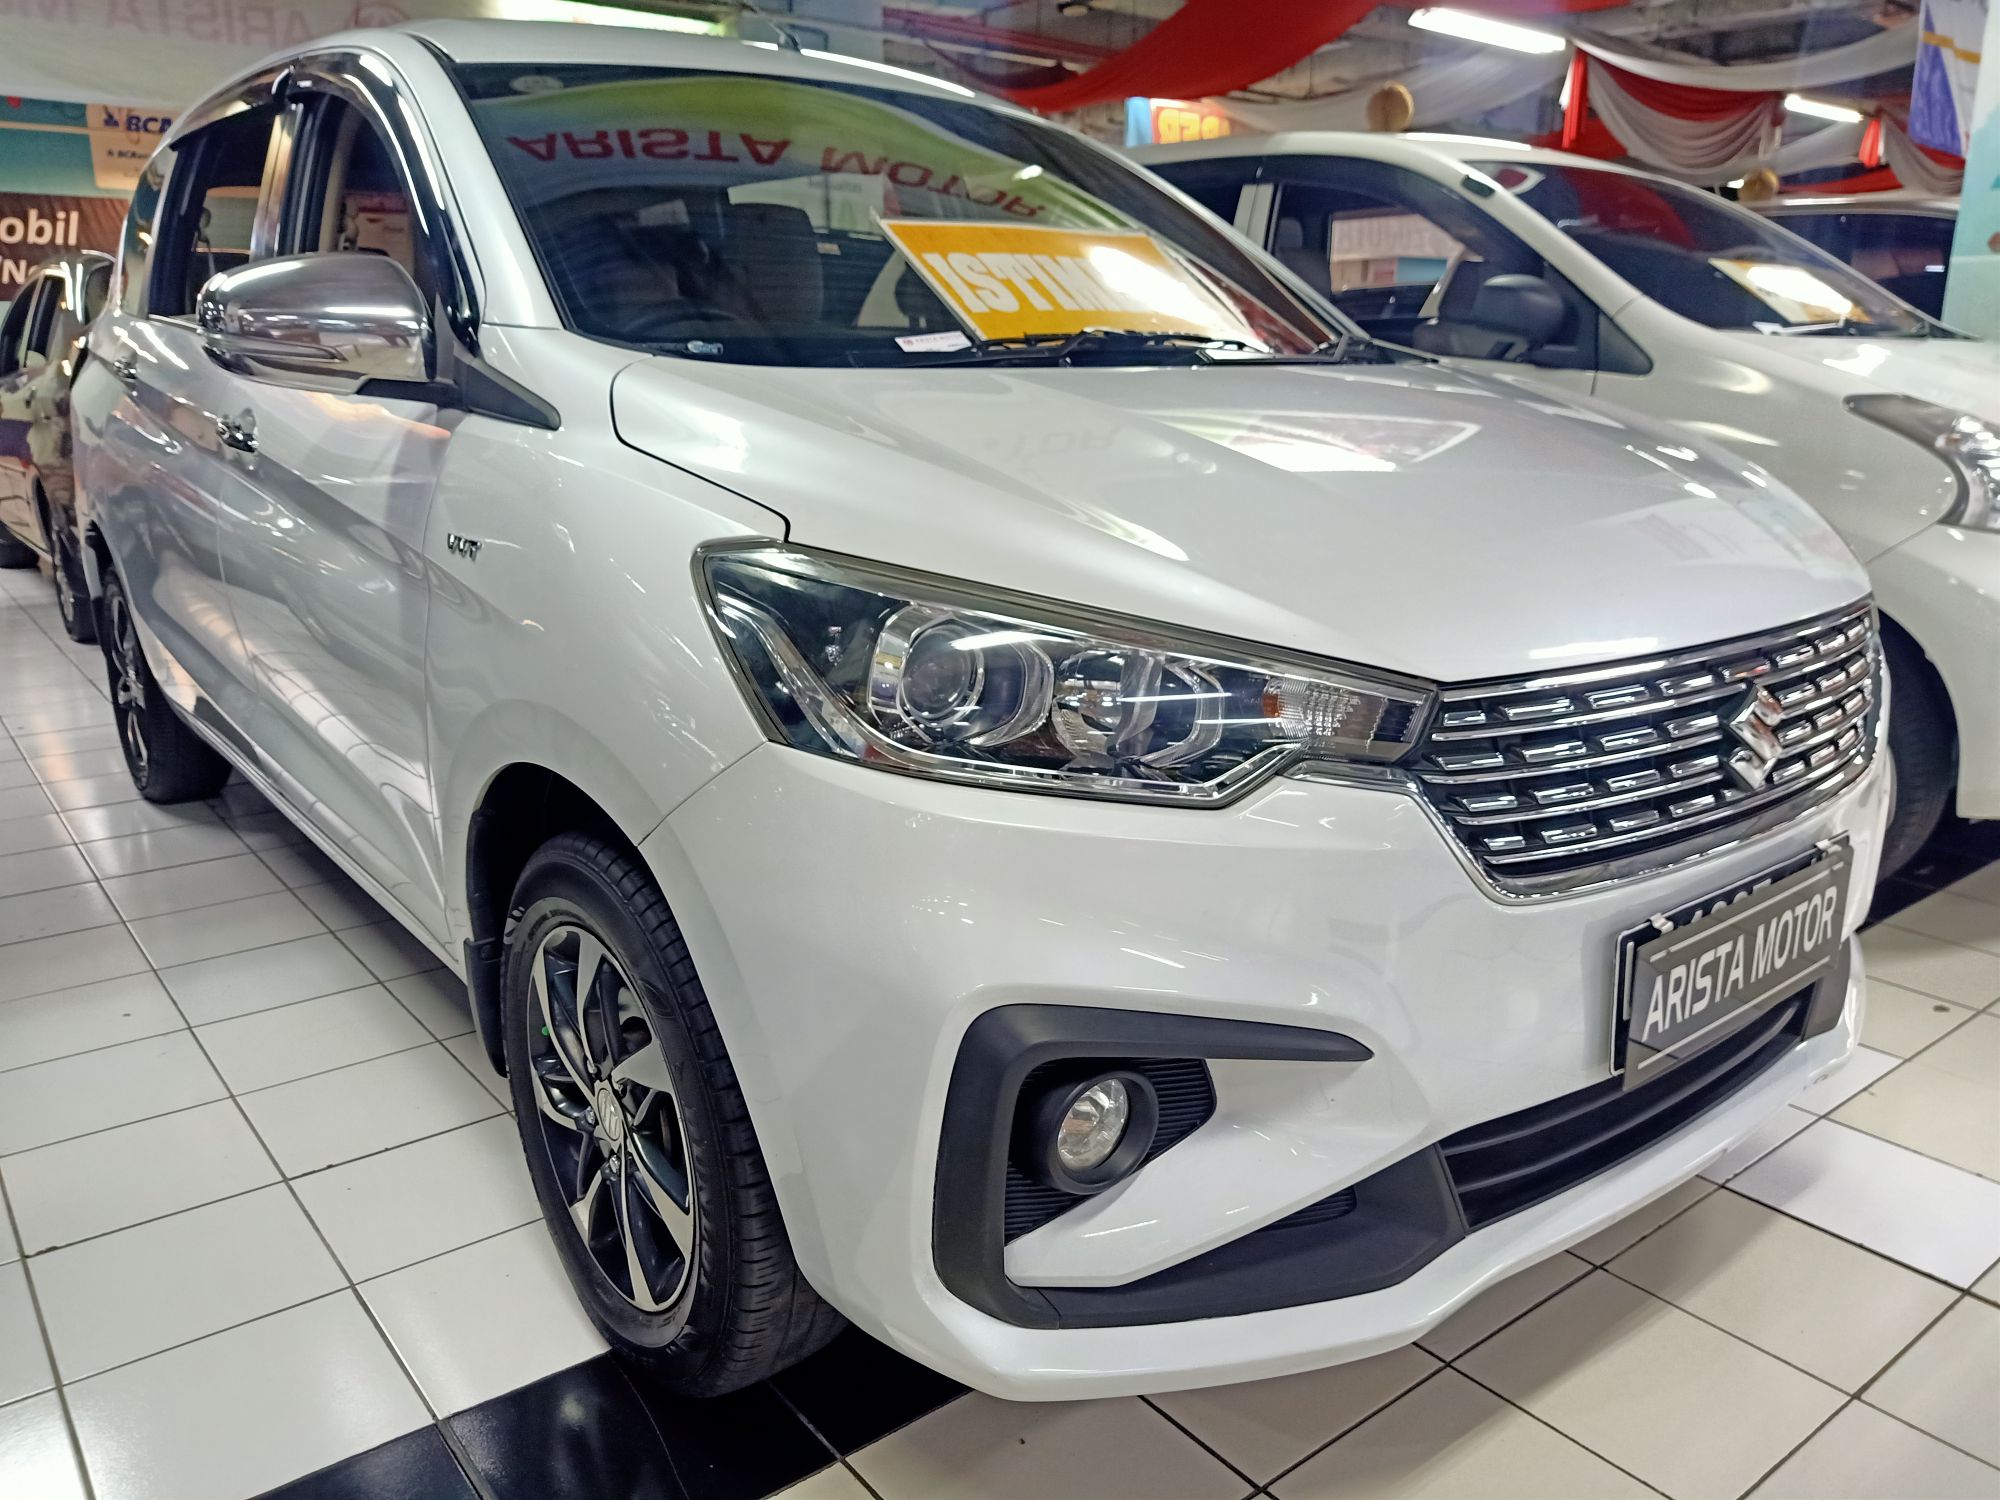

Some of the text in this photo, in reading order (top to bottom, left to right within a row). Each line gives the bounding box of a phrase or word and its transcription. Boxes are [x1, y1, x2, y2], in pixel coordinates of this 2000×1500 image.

[922, 252, 1155, 314] ISTIM
[1641, 934, 1745, 1042] ARISTA
[1750, 886, 1838, 984] MOTOR
